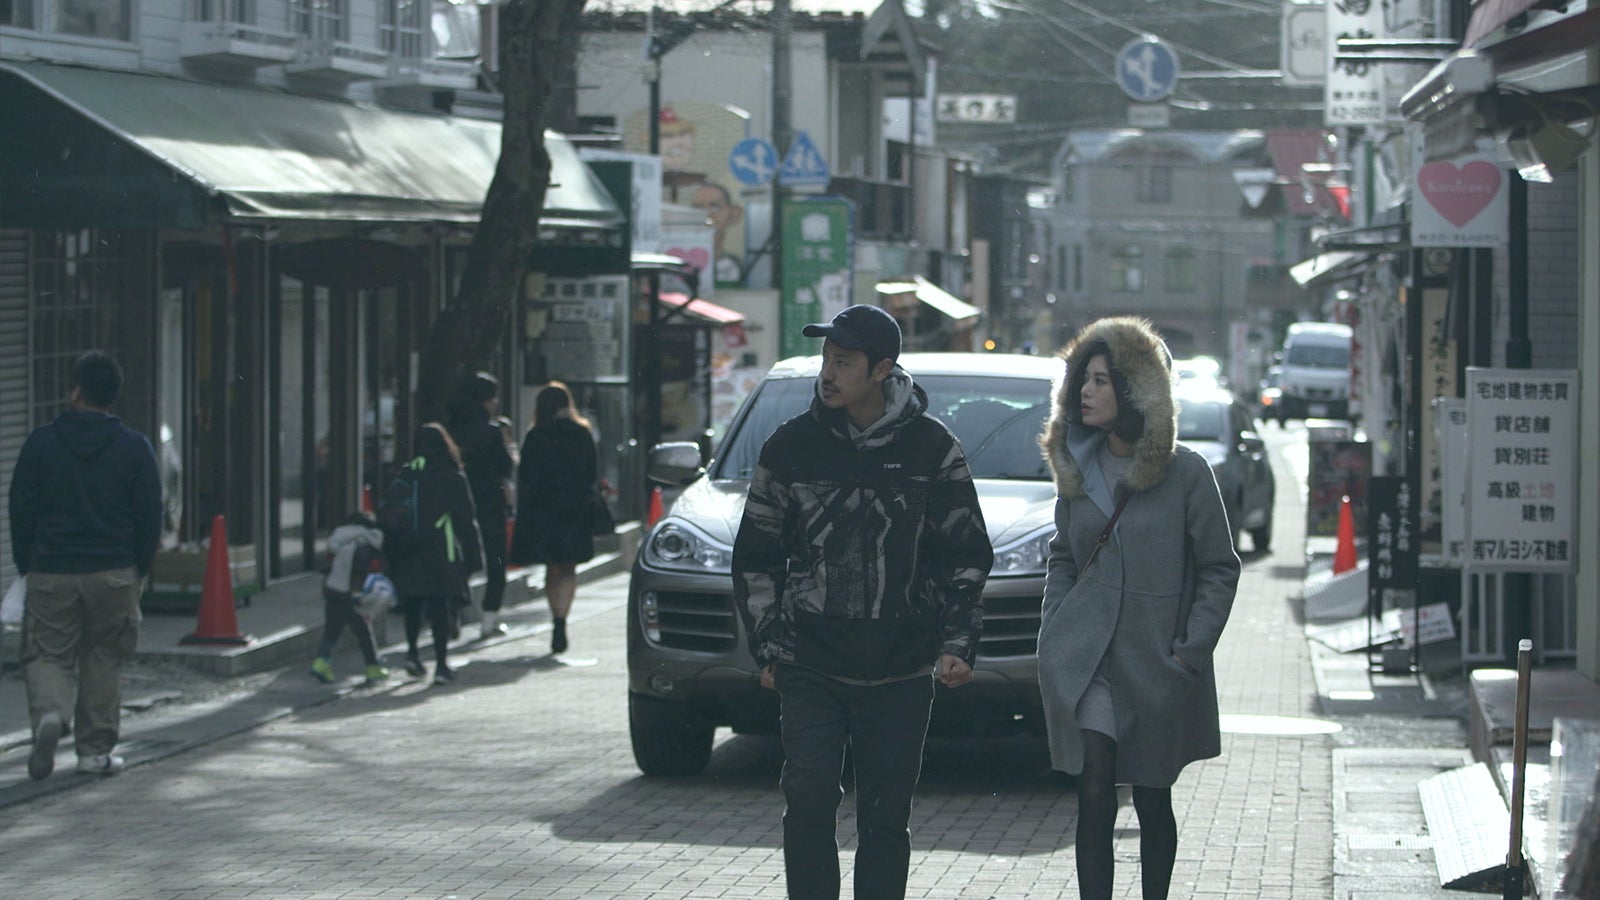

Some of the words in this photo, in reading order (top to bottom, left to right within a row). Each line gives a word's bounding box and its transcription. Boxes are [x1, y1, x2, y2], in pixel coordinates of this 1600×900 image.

[1476, 382, 1568, 400] 宅地建物売買
[1494, 415, 1551, 433] 貸店舗
[1494, 447, 1551, 465] 貸別荘
[1521, 504, 1555, 522] 建物
